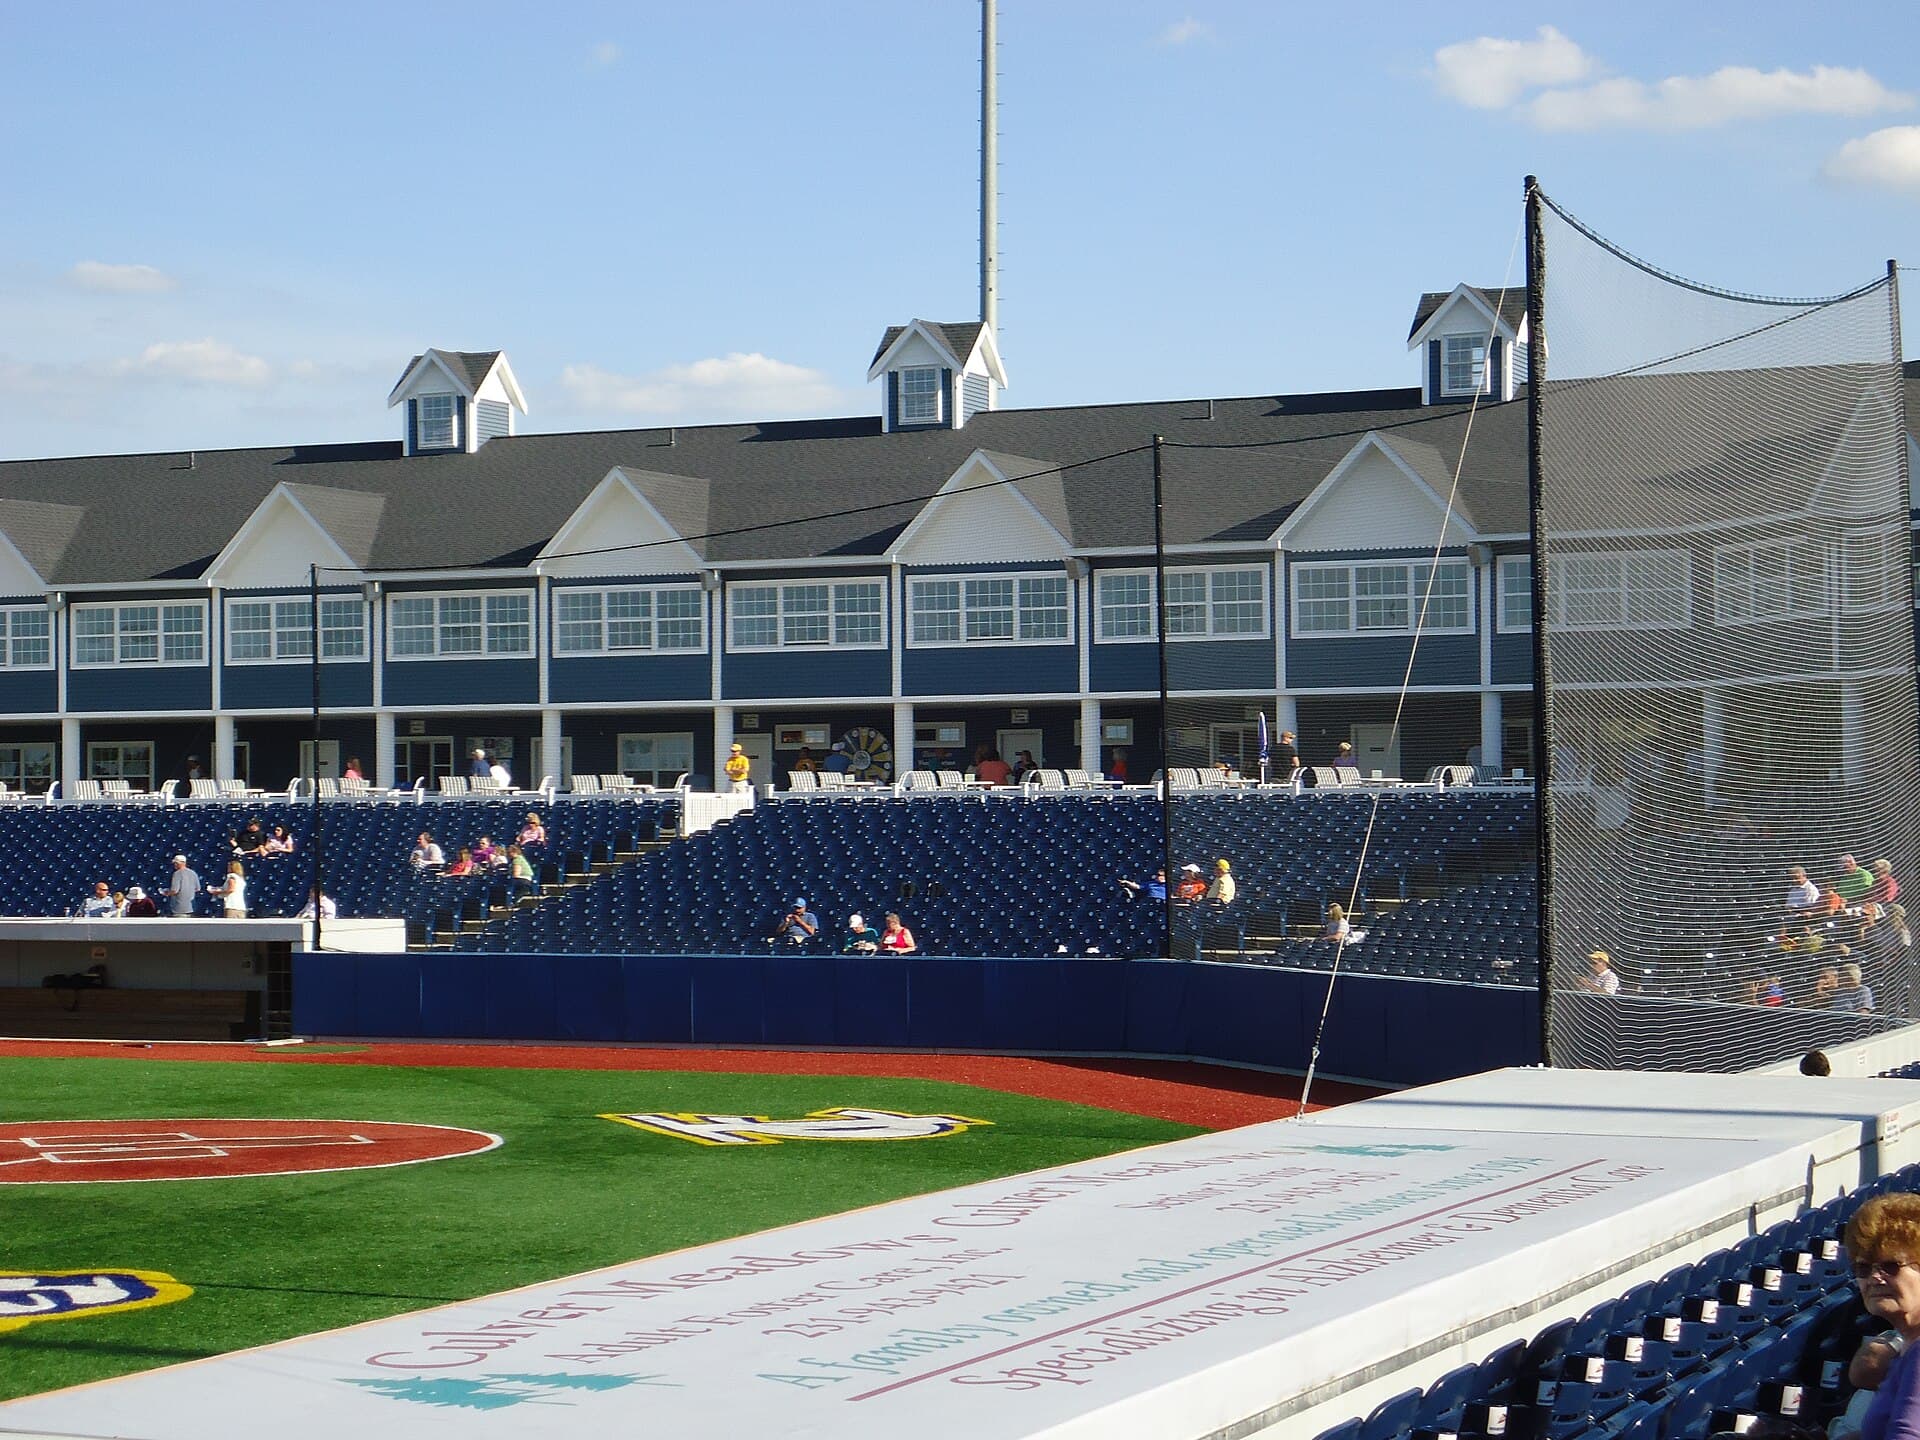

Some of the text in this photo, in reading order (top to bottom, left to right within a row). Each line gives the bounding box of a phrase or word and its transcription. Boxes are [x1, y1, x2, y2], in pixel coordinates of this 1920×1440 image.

[931, 1151, 1307, 1227] Culver Meadows
[1113, 1167, 1336, 1210] Senior Living
[365, 1235, 958, 1369] Culver Meadows
[544, 1248, 1013, 1364] Adult Foster Care, Inc.
[755, 1157, 1554, 1389] A family owned and operated business since 1994
[761, 1274, 1027, 1338] 231-943-9421
[949, 1302, 1290, 1390] Specializing
[1210, 1287, 1309, 1301] in
[1266, 1232, 1464, 1287] Alzheimer
[1446, 1184, 1613, 1223] Dementia
[1569, 1165, 1664, 1183] Care
